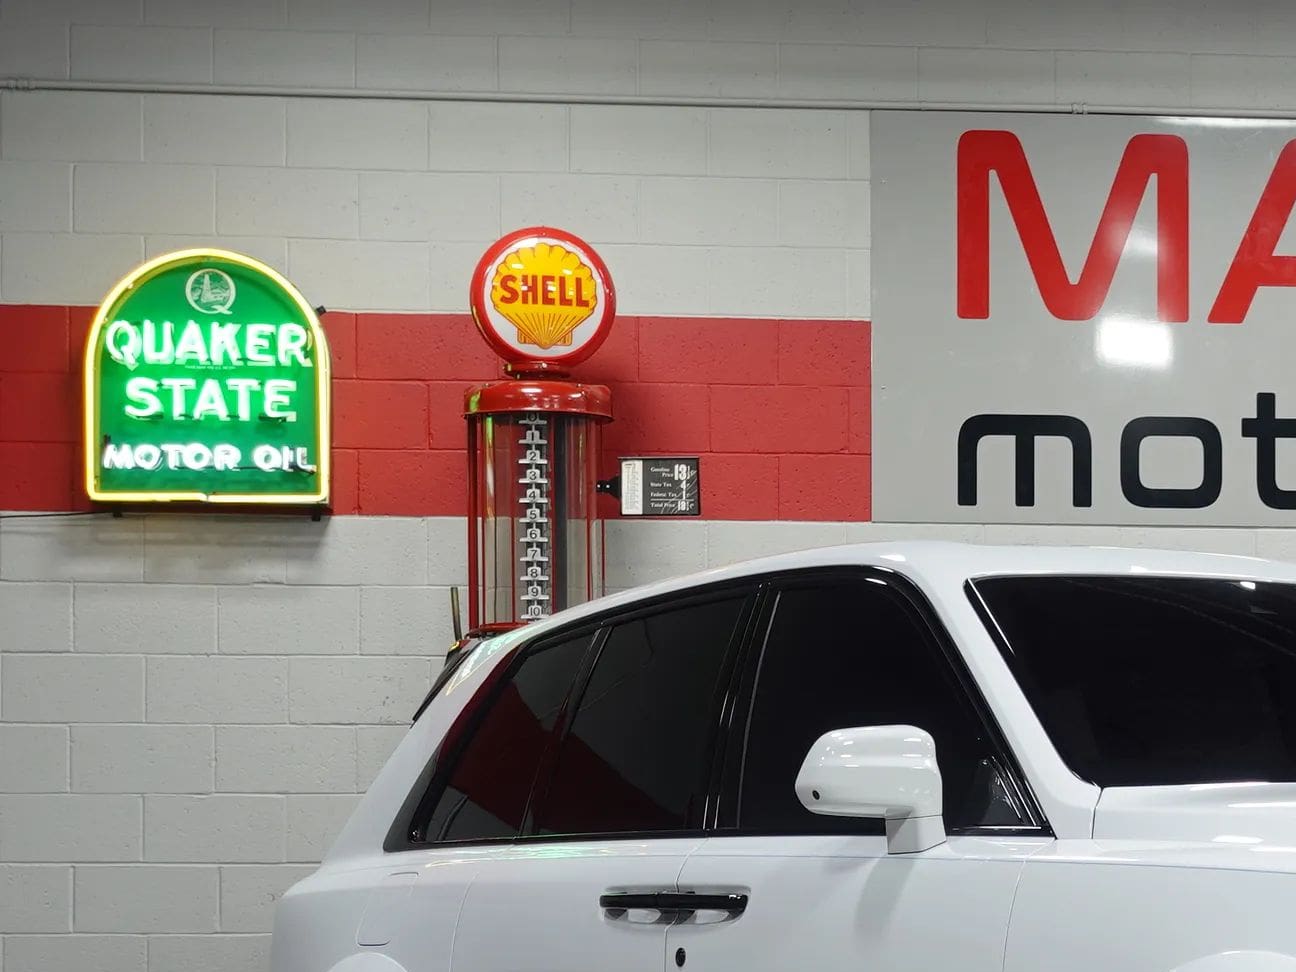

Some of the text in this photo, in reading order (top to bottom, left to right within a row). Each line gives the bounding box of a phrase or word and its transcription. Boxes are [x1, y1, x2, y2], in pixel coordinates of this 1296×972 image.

[499, 274, 590, 308] SHELL
[105, 319, 313, 371] QUAKER
[125, 377, 297, 421] STATE
[103, 443, 317, 473] MOTOR OIL
